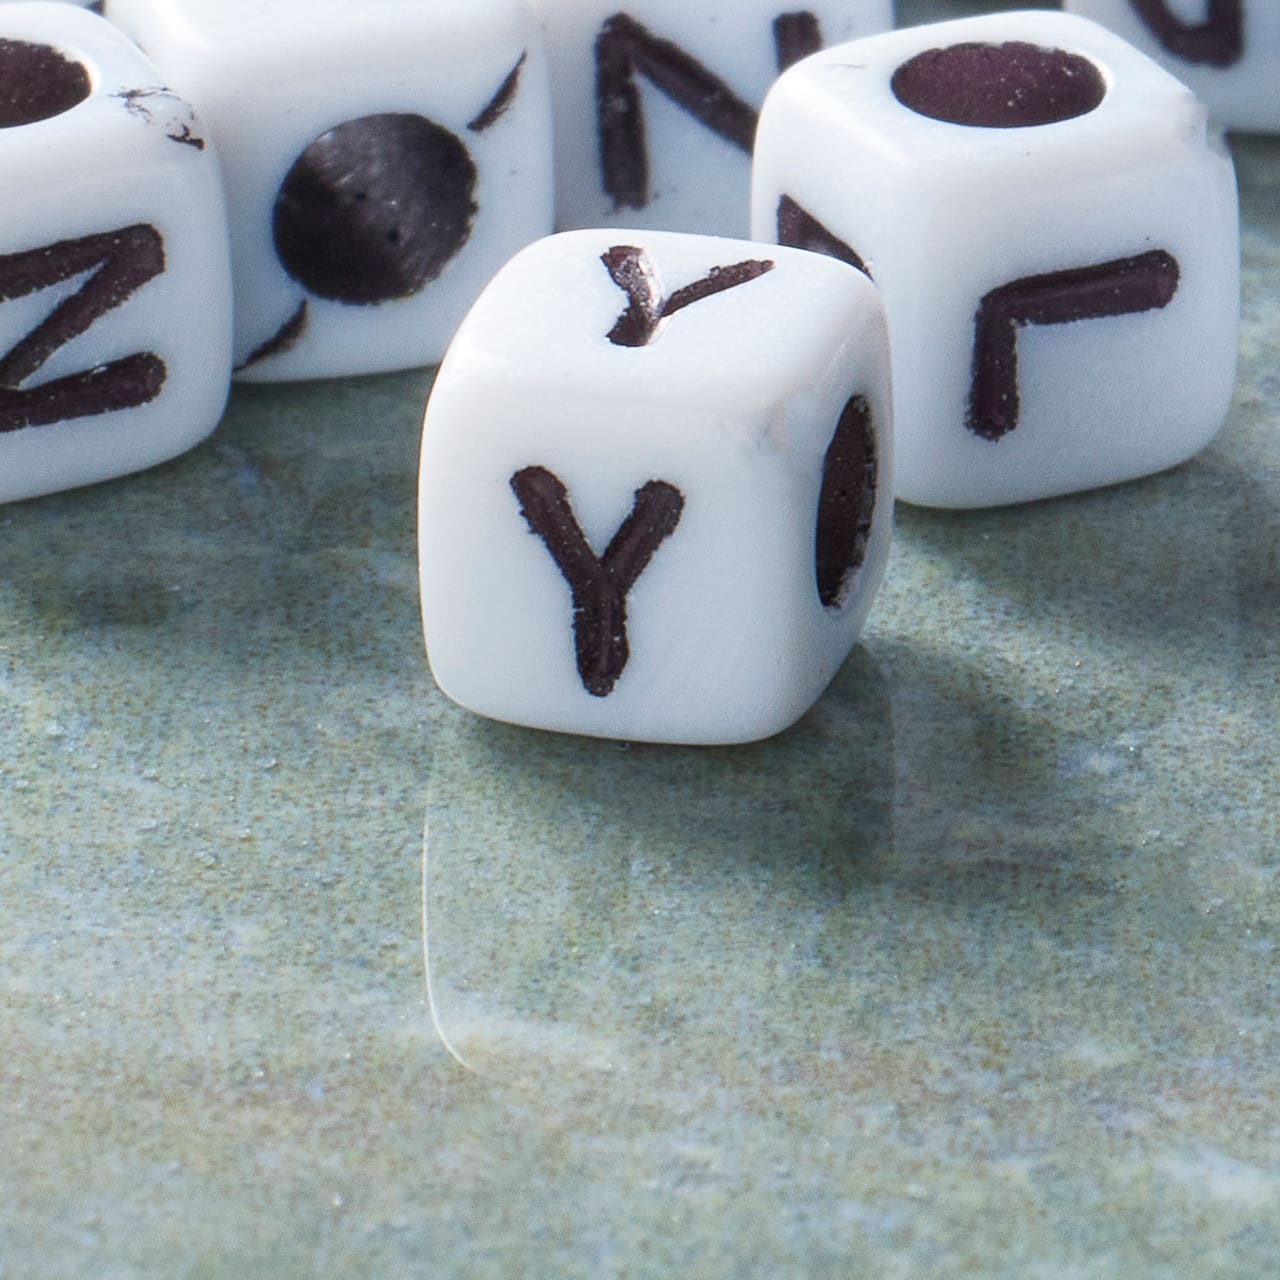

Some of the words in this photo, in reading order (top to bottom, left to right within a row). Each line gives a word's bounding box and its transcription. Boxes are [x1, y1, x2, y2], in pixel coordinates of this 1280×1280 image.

[601, 245, 775, 348] Y
[964, 248, 1182, 441] L
[509, 465, 685, 697] Y
